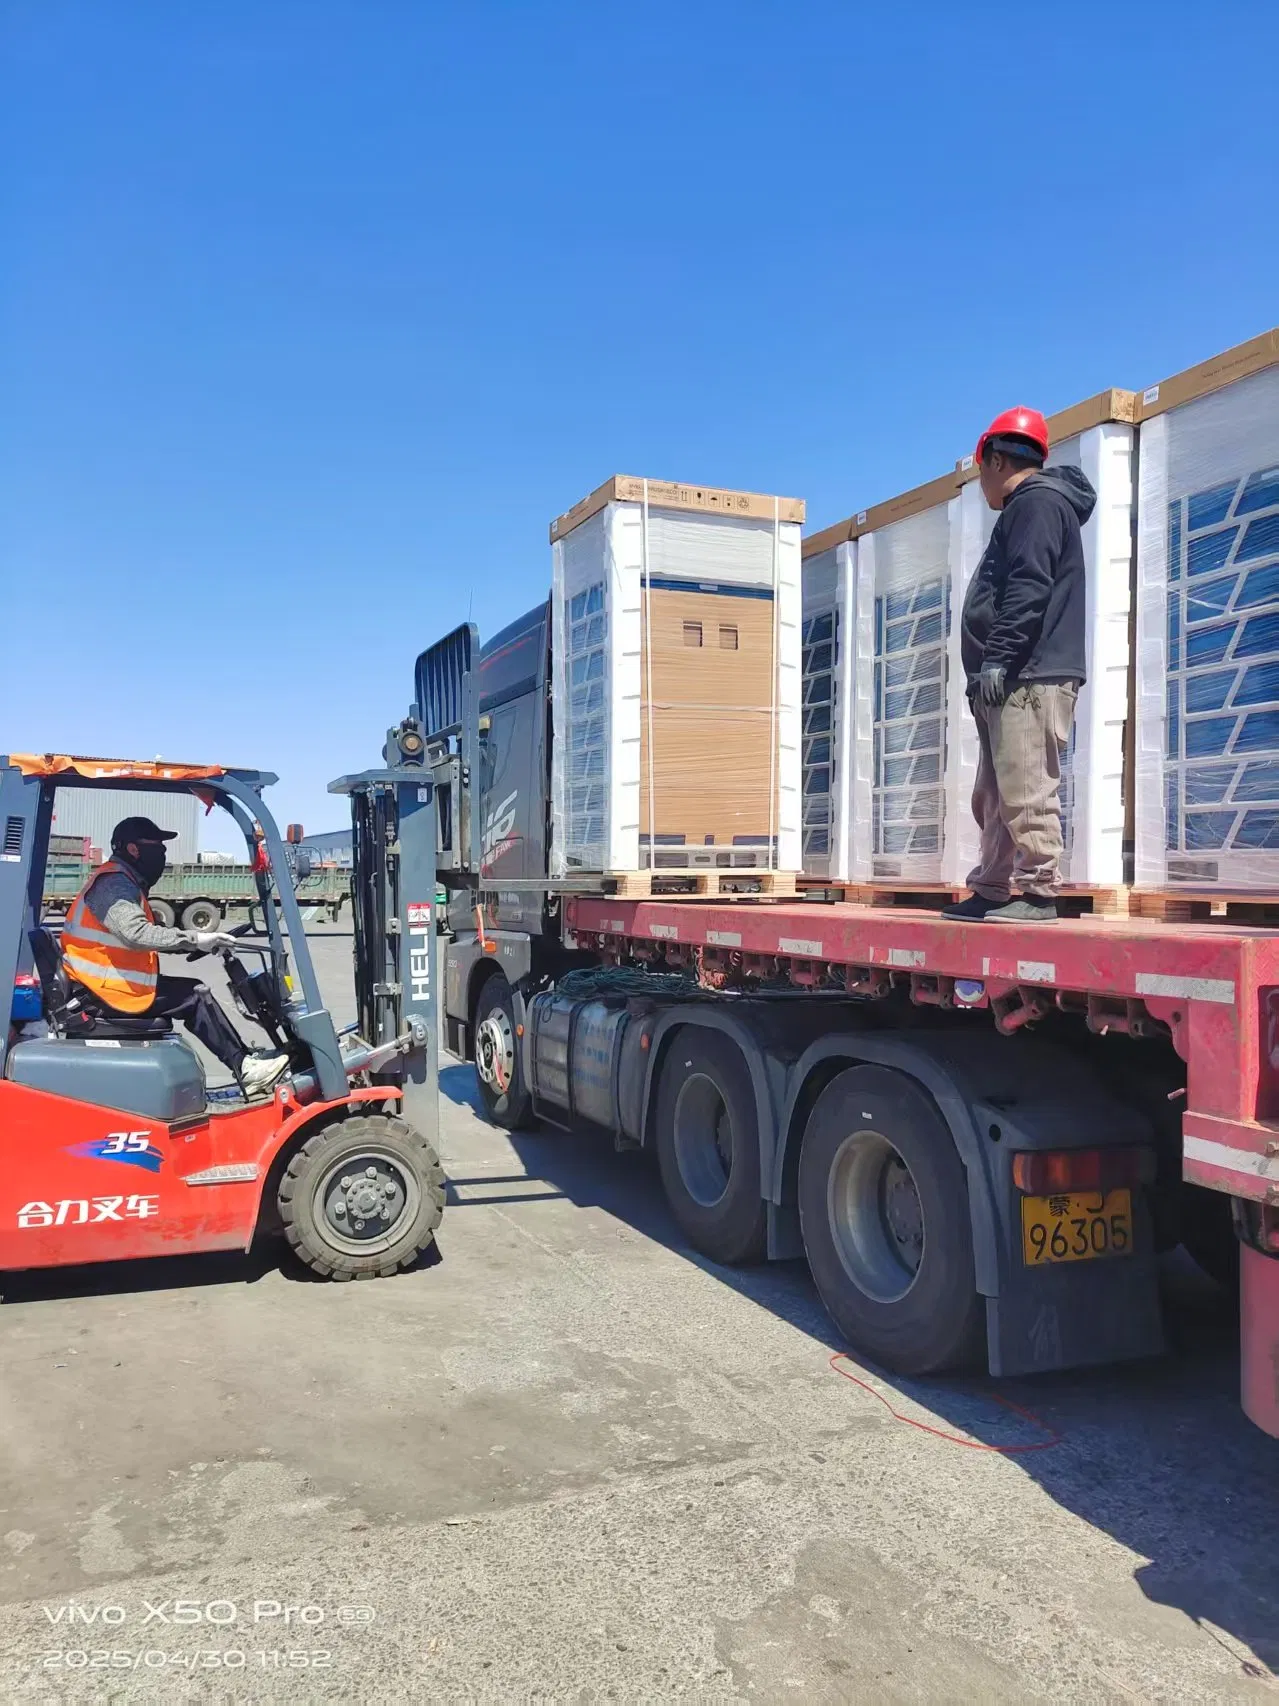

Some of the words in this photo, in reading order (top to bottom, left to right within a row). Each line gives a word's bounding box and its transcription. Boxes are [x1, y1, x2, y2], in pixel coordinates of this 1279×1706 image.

[409, 927, 430, 1001] HELI
[101, 1131, 152, 1154] 35
[16, 1195, 160, 1228] 合力叉车
[1030, 1214, 1128, 1260] 96305
